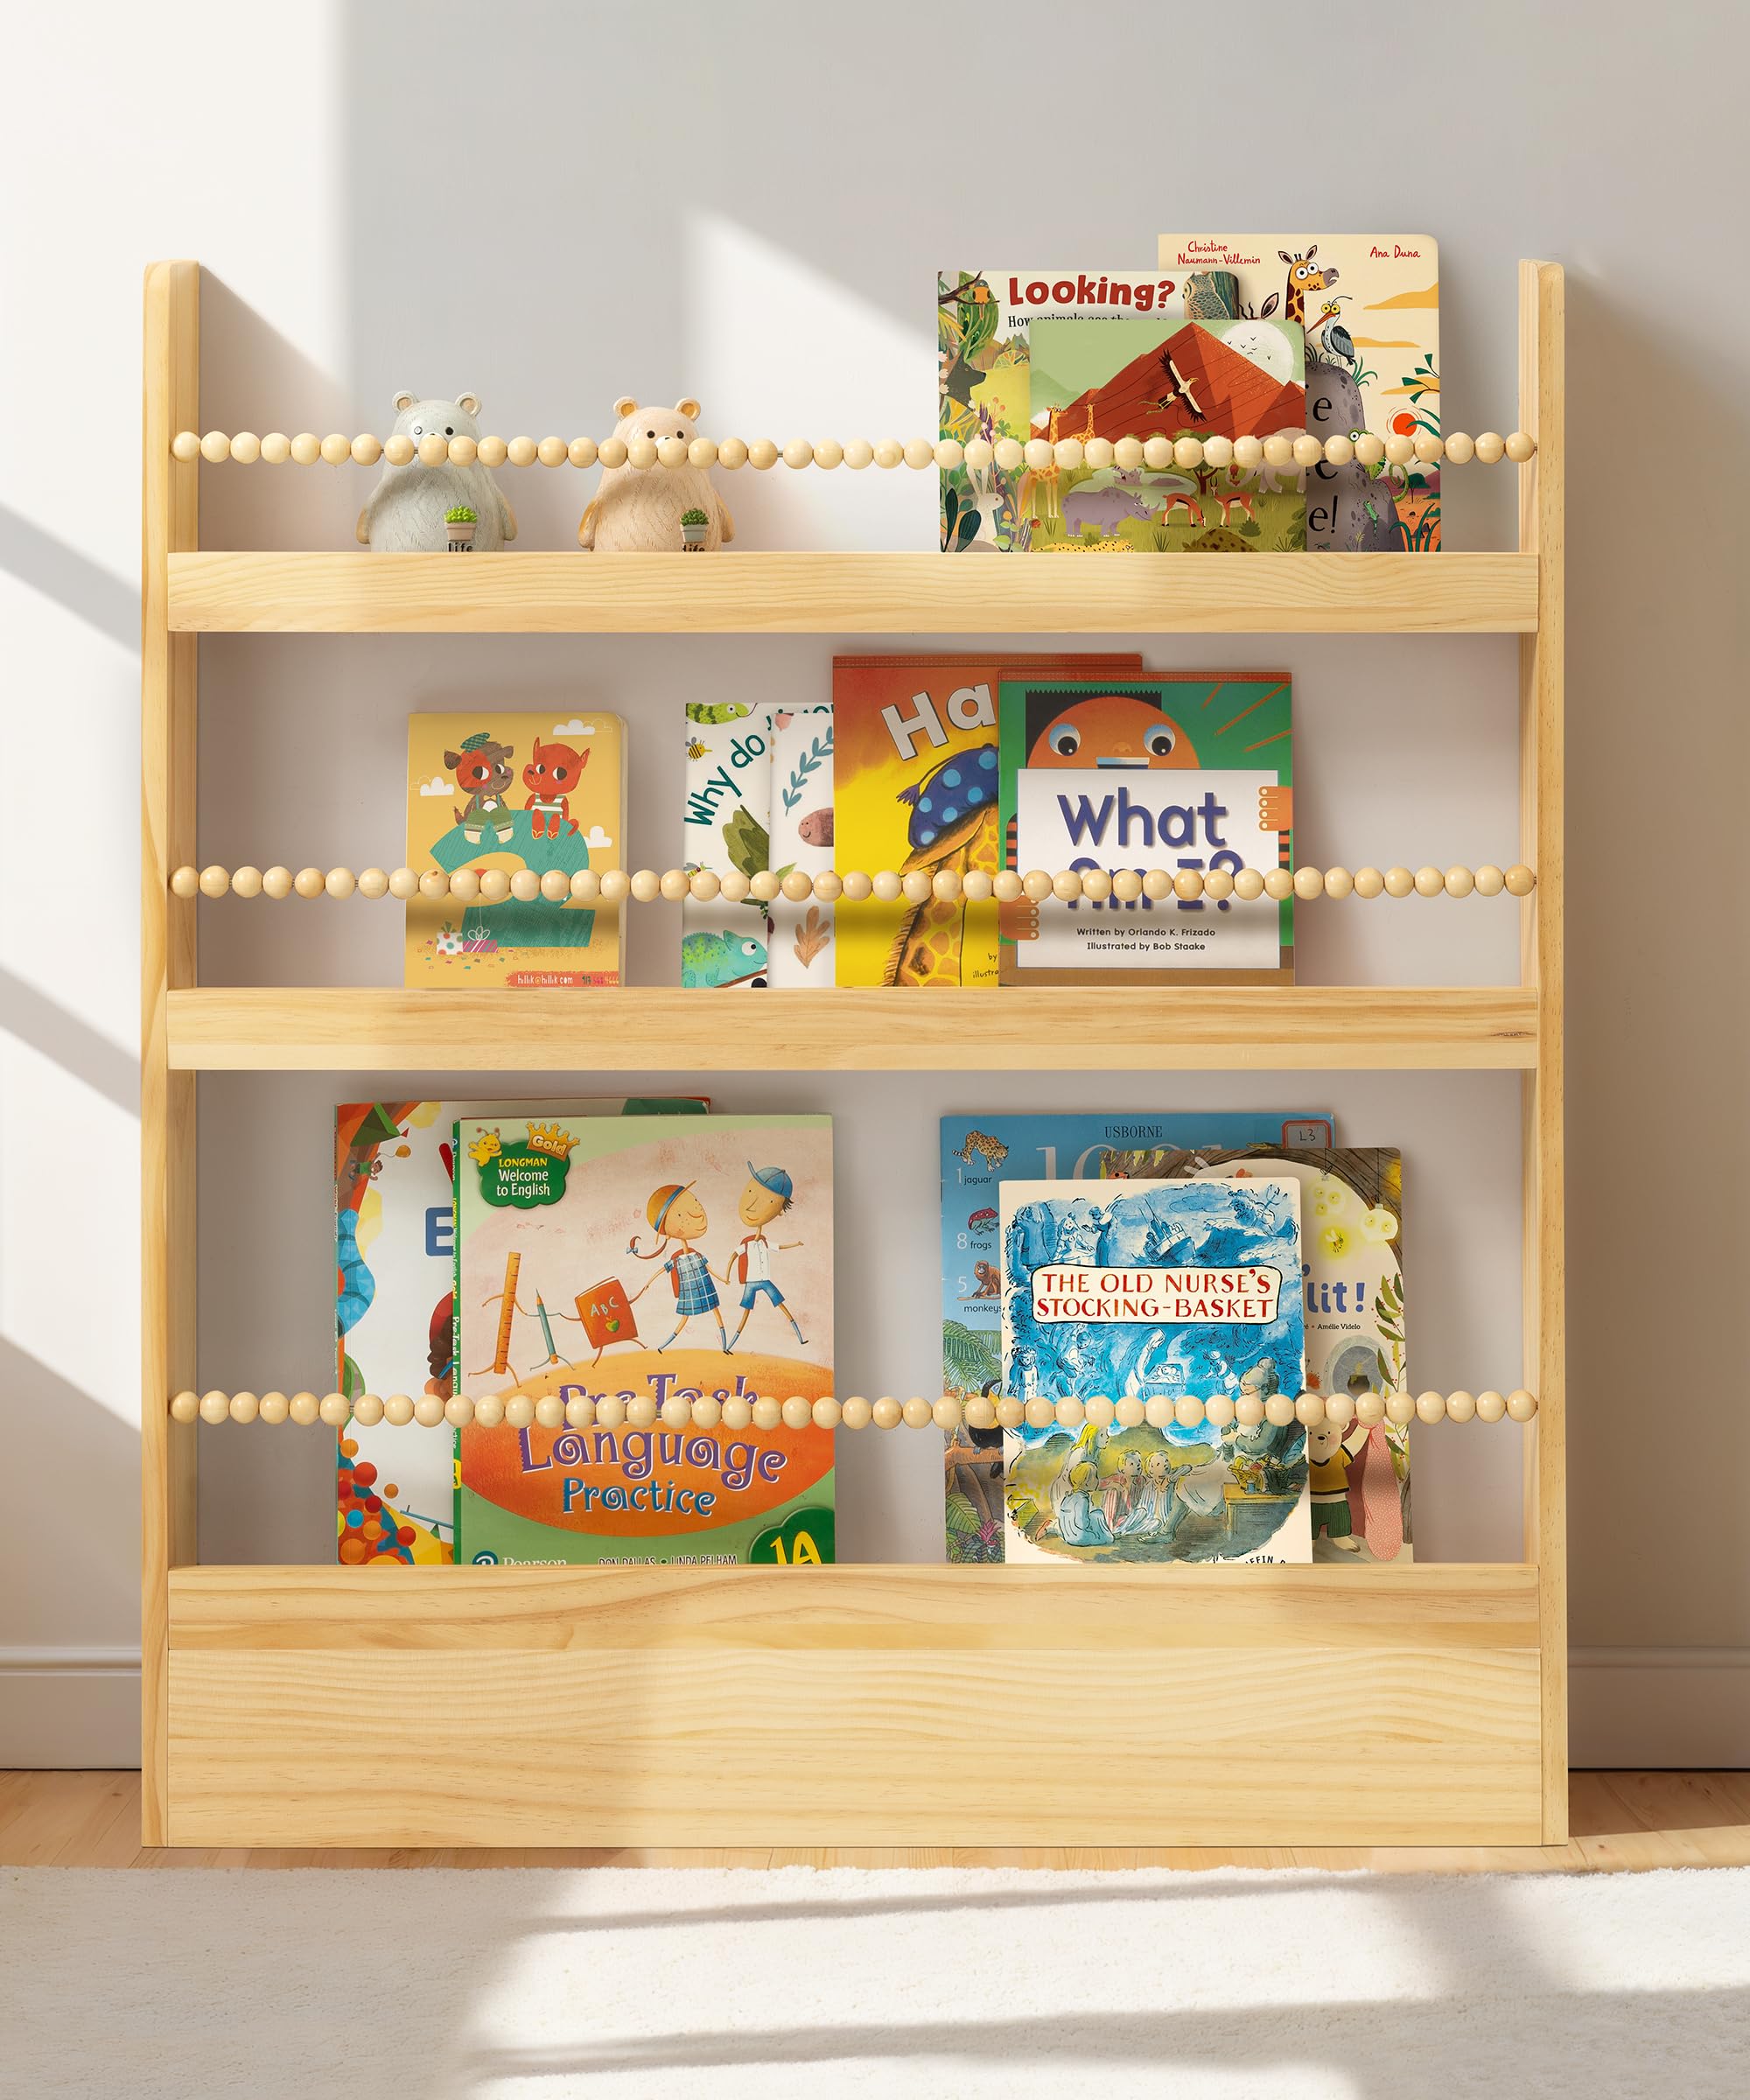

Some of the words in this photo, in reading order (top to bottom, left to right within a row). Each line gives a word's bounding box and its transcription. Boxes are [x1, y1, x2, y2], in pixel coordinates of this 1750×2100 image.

[1187, 241, 1228, 253] Christine
[1369, 246, 1390, 259] Ana
[1394, 245, 1421, 259] Duna
[1177, 253, 1261, 265] Naumann-Villemin
[1009, 274, 1176, 312] Looking?
[448, 542, 473, 552] life
[683, 765, 743, 826] Why
[730, 734, 766, 768] do
[1056, 786, 1227, 847] What
[1076, 928, 1111, 937] Written
[1114, 928, 1125, 939] by
[1128, 928, 1166, 937] Orlando
[1169, 928, 1179, 937] K.
[1181, 928, 1216, 937] Frizado
[1087, 942, 1137, 951] Illustrated
[1138, 942, 1150, 952] by
[1152, 942, 1172, 951] Bob
[1173, 942, 1206, 951] Staake
[987, 952, 998, 963] by
[1104, 1125, 1163, 1138] USBORNE
[1298, 1128, 1317, 1142] L3
[532, 1135, 567, 1156] Gold
[498, 1157, 549, 1168] LONGMAN
[498, 1169, 550, 1182] Welcome
[963, 1175, 993, 1186] jaguar
[496, 1185, 508, 1197] to
[511, 1182, 550, 1199] English
[956, 1232, 968, 1250] 8
[970, 1241, 992, 1251] frogs
[958, 1277, 967, 1293] 5
[1041, 1273, 1089, 1293] THE
[1100, 1273, 1153, 1293] OLD
[1165, 1268, 1271, 1294] NURSE'S
[963, 1304, 1002, 1314] monkeys
[1037, 1298, 1274, 1319] STOCKING-BASKET
[518, 1425, 788, 1492] Language
[562, 1476, 718, 1517] Practice
[769, 1530, 822, 1564] 1A
